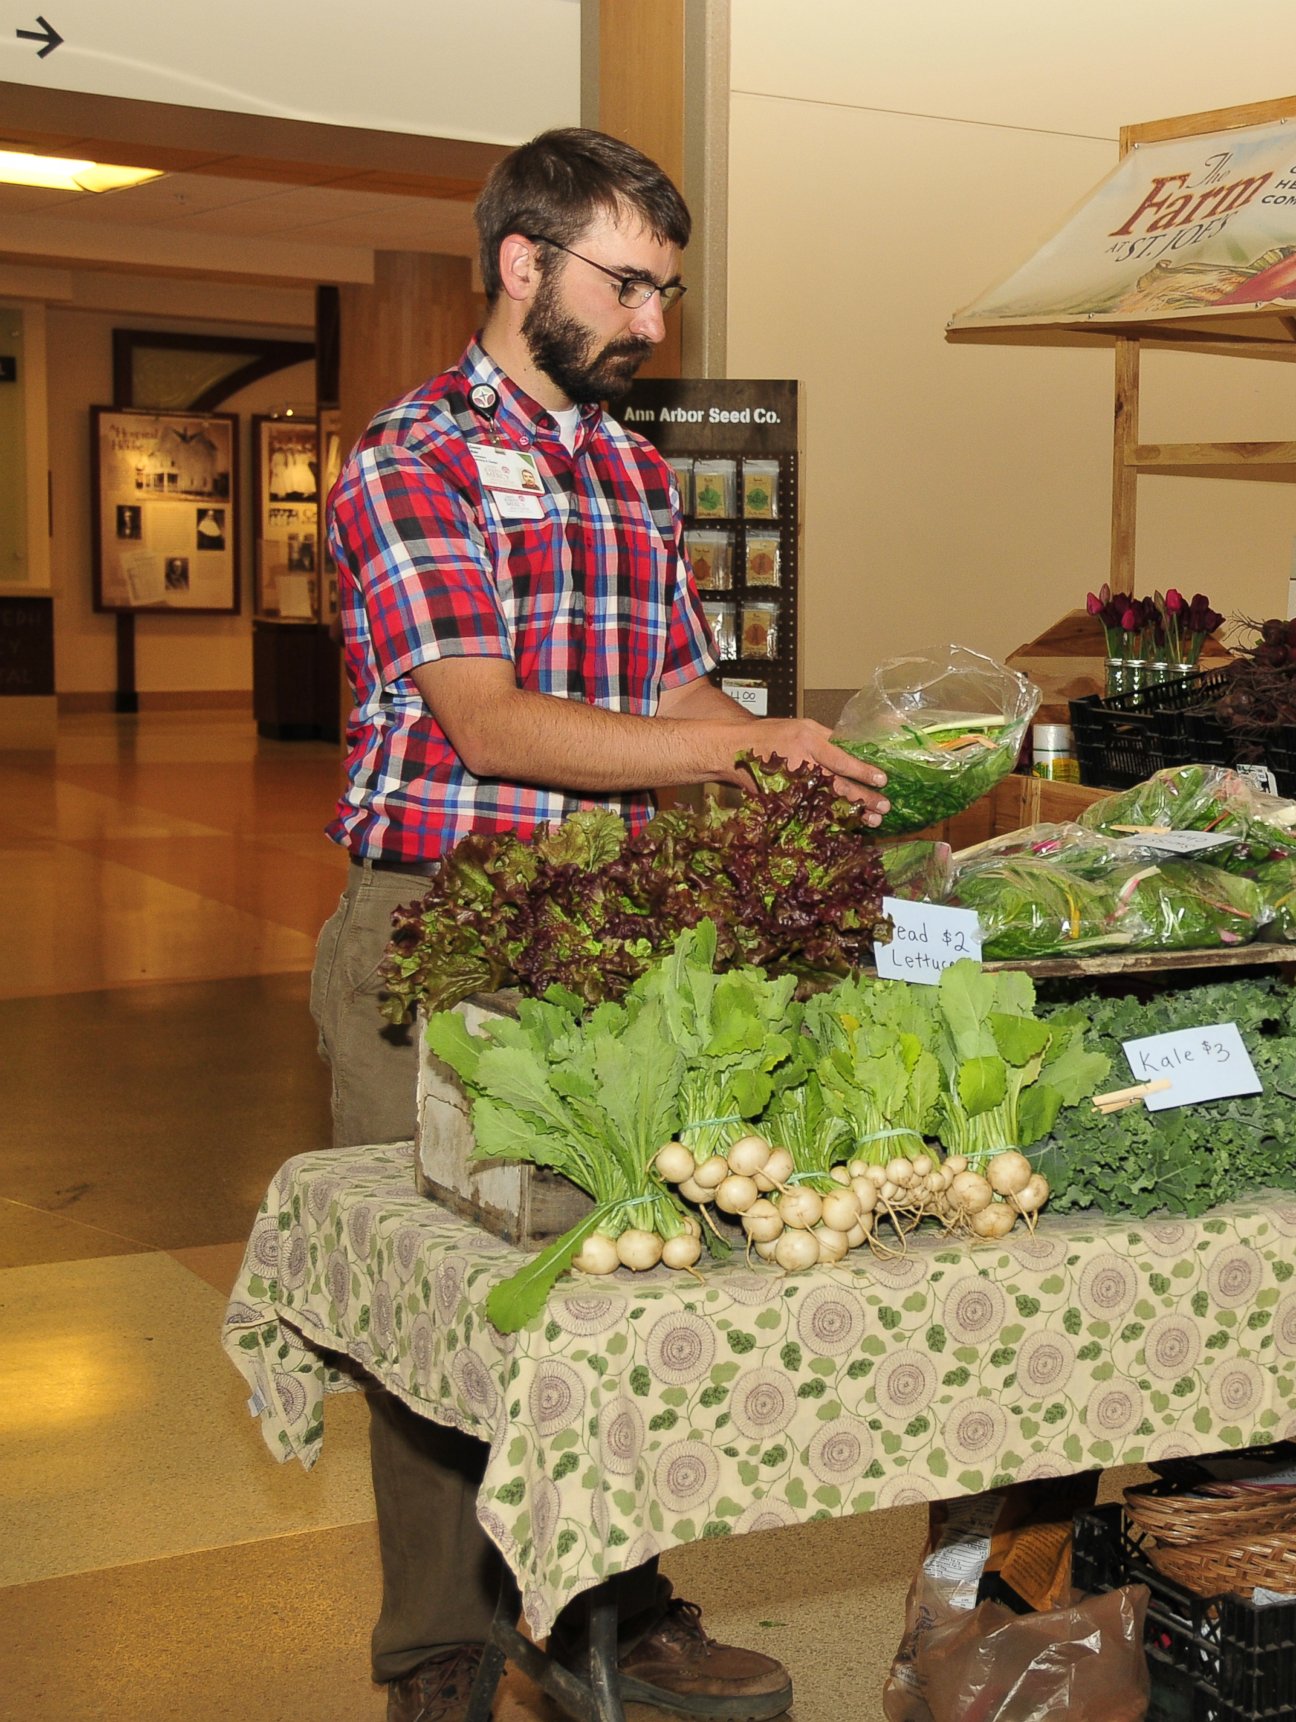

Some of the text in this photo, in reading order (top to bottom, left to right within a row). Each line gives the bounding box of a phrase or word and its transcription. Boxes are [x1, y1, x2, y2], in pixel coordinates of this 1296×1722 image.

[1186, 152, 1234, 189] The
[1108, 170, 1275, 236] Farm
[1105, 239, 1130, 254] AT
[1116, 234, 1167, 262] ST.
[624, 406, 781, 424] Ann Arbor Seed Co.
[897, 922, 971, 953] ead $2
[1139, 1040, 1231, 1072] Kale $3
